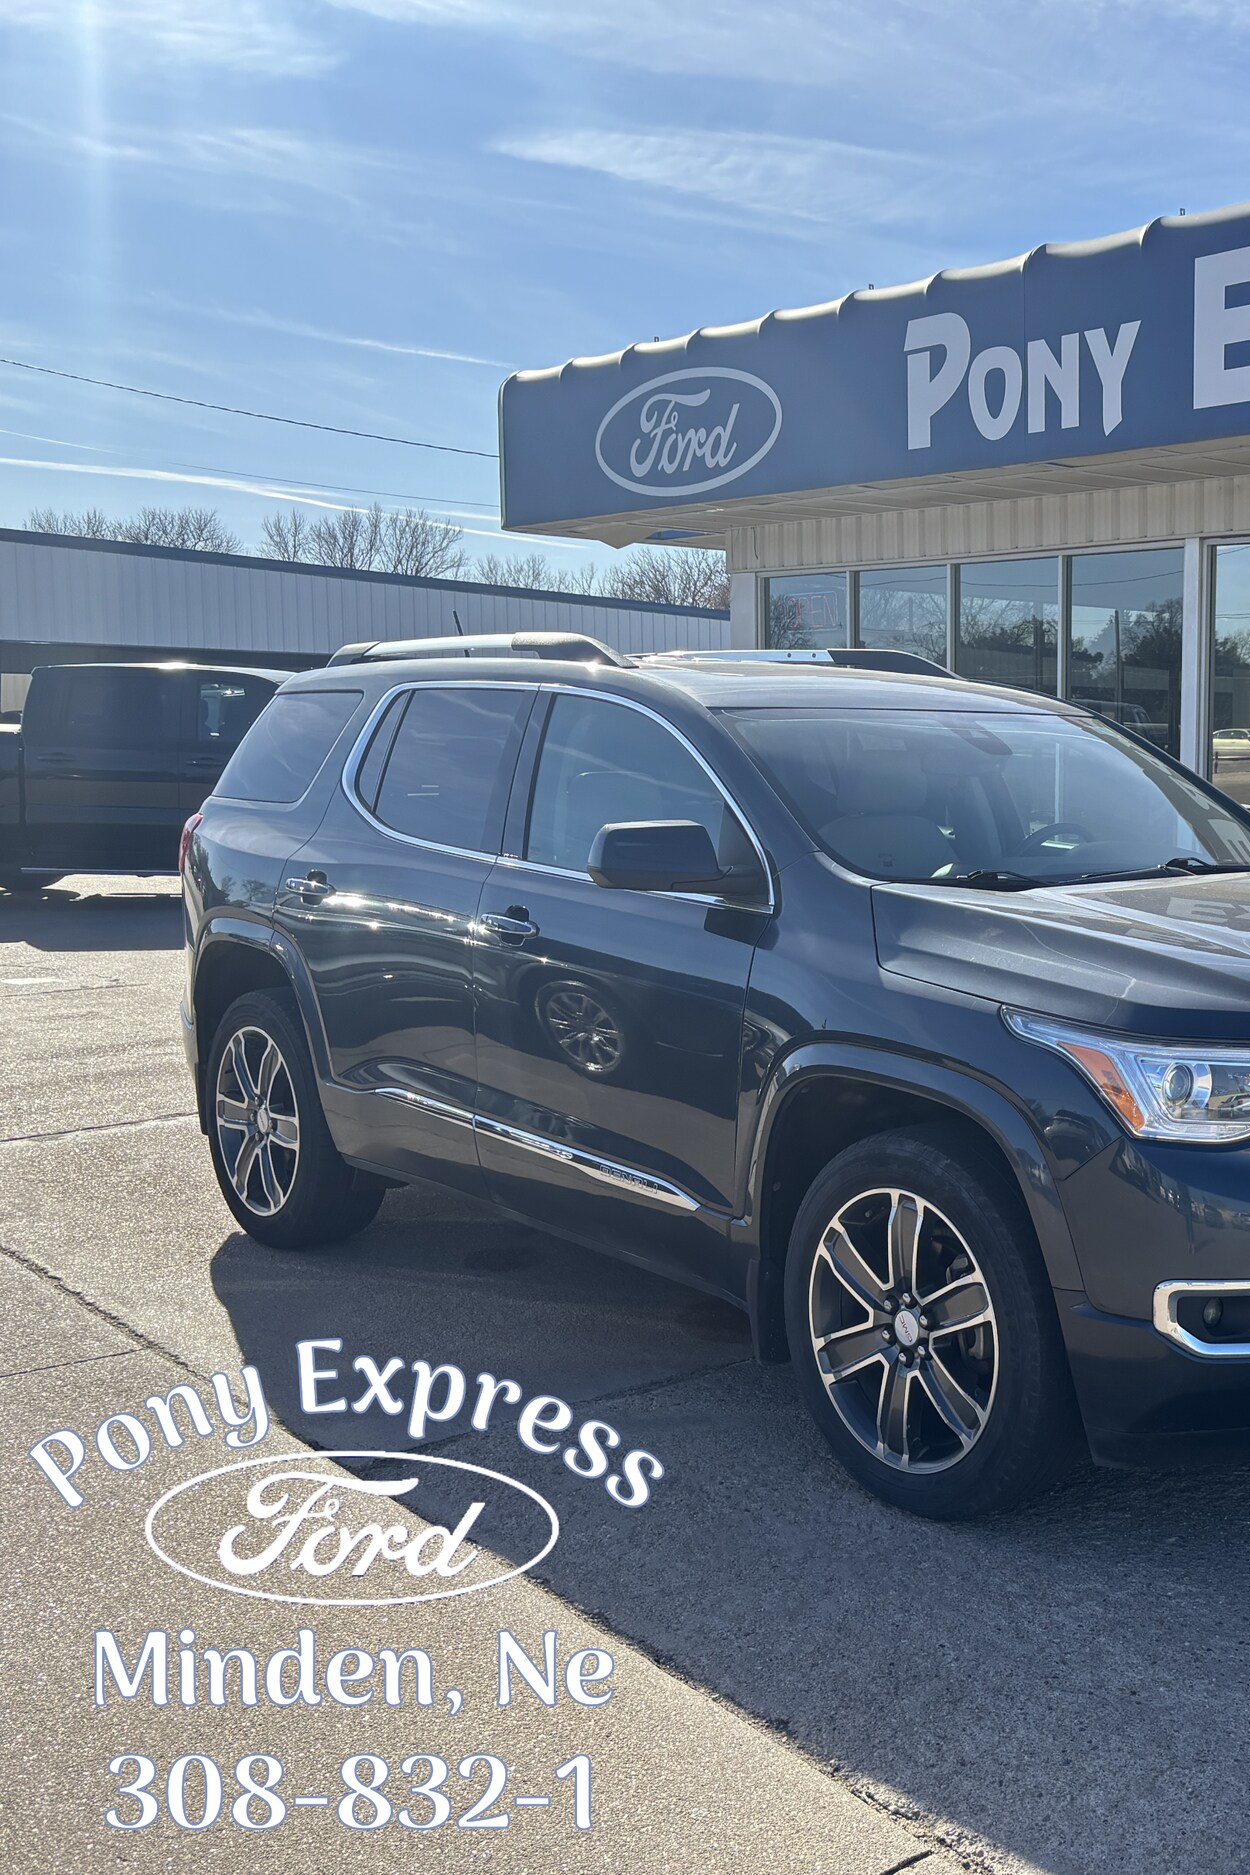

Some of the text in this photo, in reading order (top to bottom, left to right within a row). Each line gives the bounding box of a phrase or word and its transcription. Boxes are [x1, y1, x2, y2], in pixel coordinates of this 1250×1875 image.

[903, 312, 1142, 450] PONY
[630, 388, 740, 478] Ford
[786, 594, 837, 628] OPEN
[600, 1164, 658, 1194] DENALI
